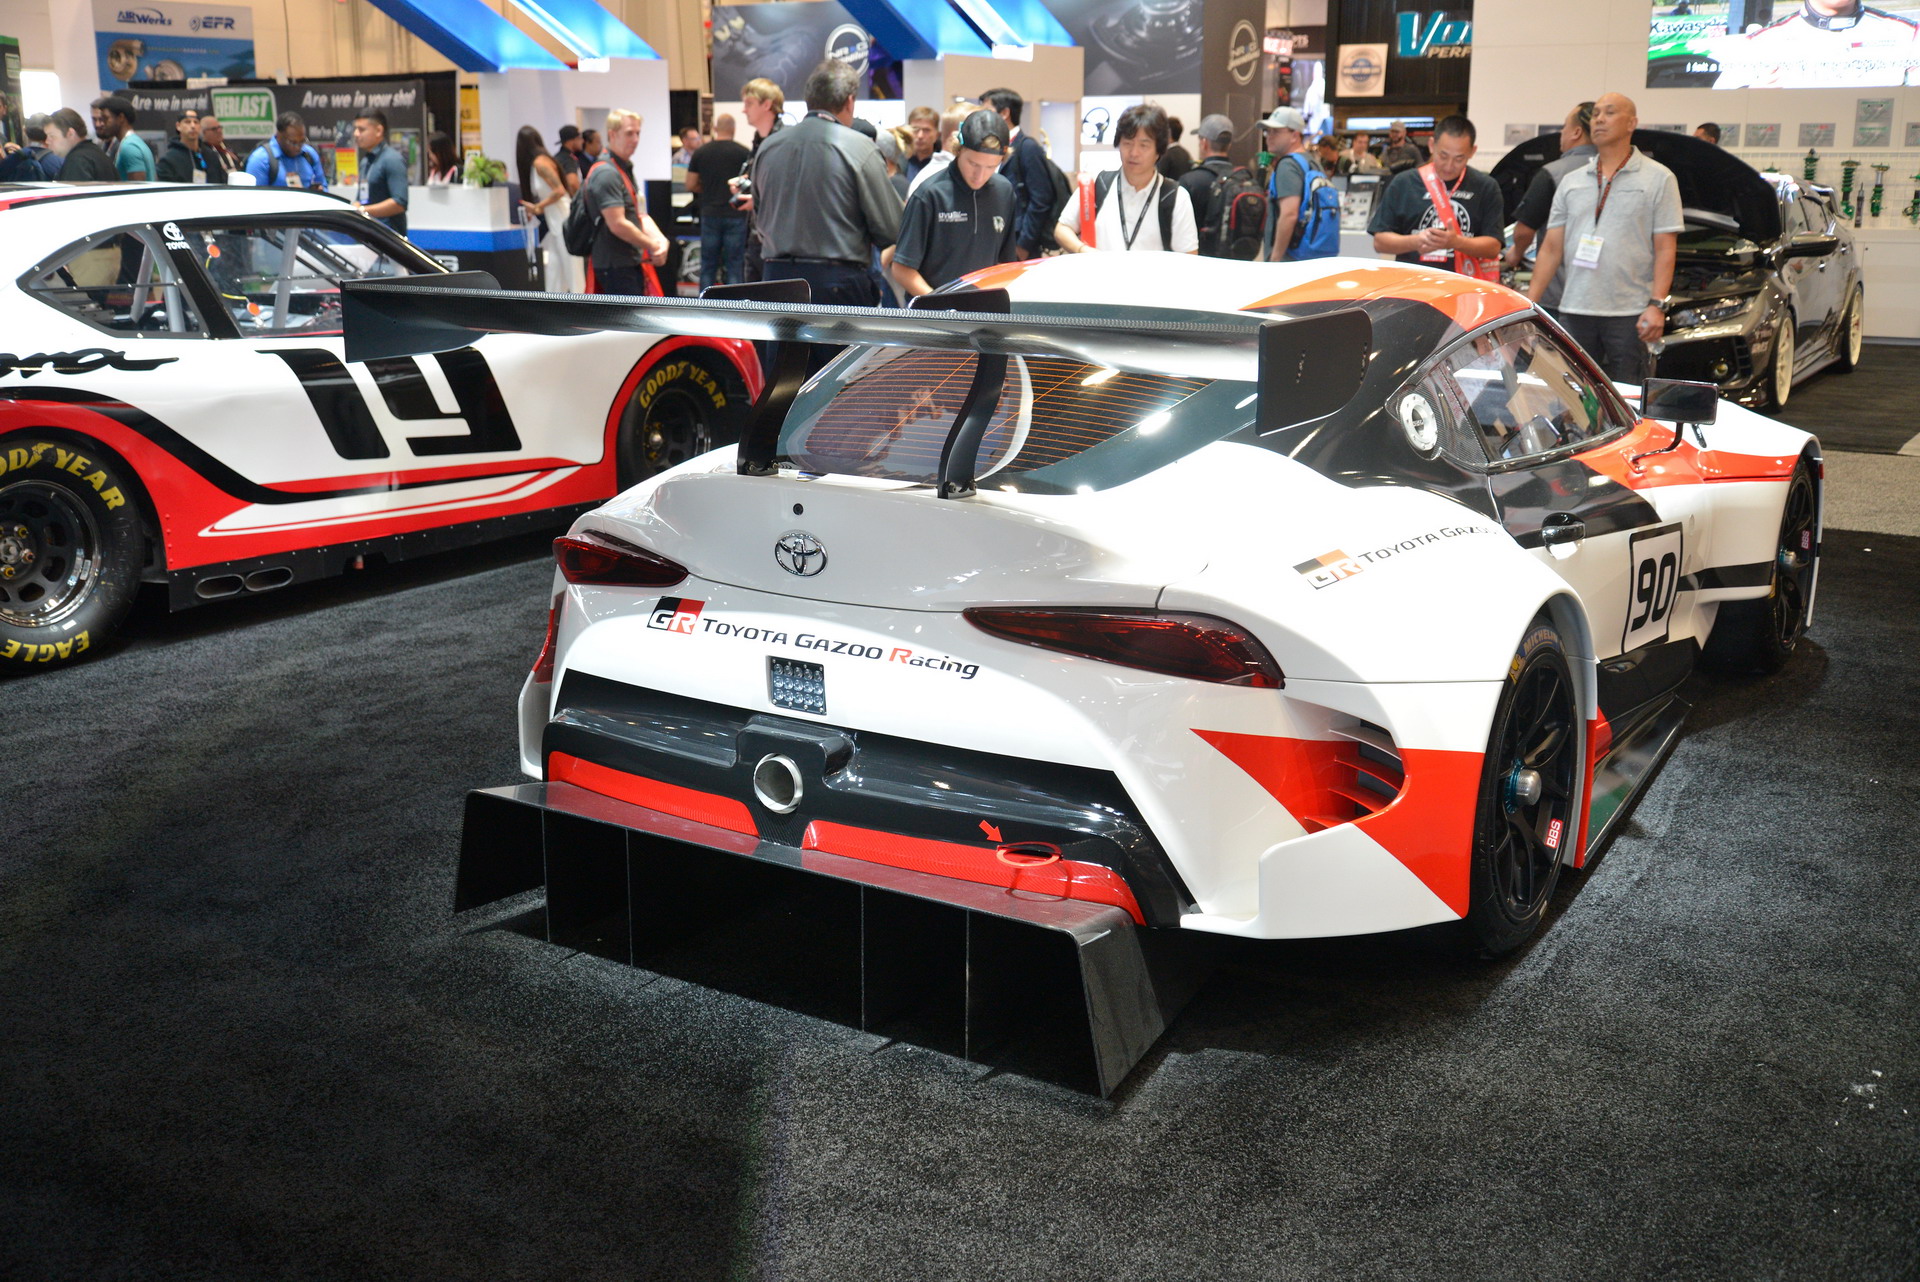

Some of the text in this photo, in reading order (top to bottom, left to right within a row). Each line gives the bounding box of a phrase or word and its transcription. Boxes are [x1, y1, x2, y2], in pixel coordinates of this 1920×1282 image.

[1397, 10, 1472, 58] Vo
[132, 94, 151, 110] Are
[154, 99, 171, 110] we
[214, 95, 270, 118] EVERLAST
[301, 90, 328, 108] Are
[331, 95, 351, 108] we
[353, 88, 367, 108] in
[1358, 532, 1441, 564] TOYOTA
[1801, 530, 1810, 549] BBS
[1630, 551, 1677, 633] 90
[1, 629, 91, 664] EAGLE
[702, 617, 788, 646] TOYOTA
[794, 633, 883, 660] GAZOO
[888, 647, 980, 680] Racing
[1546, 820, 1561, 848] BBS
